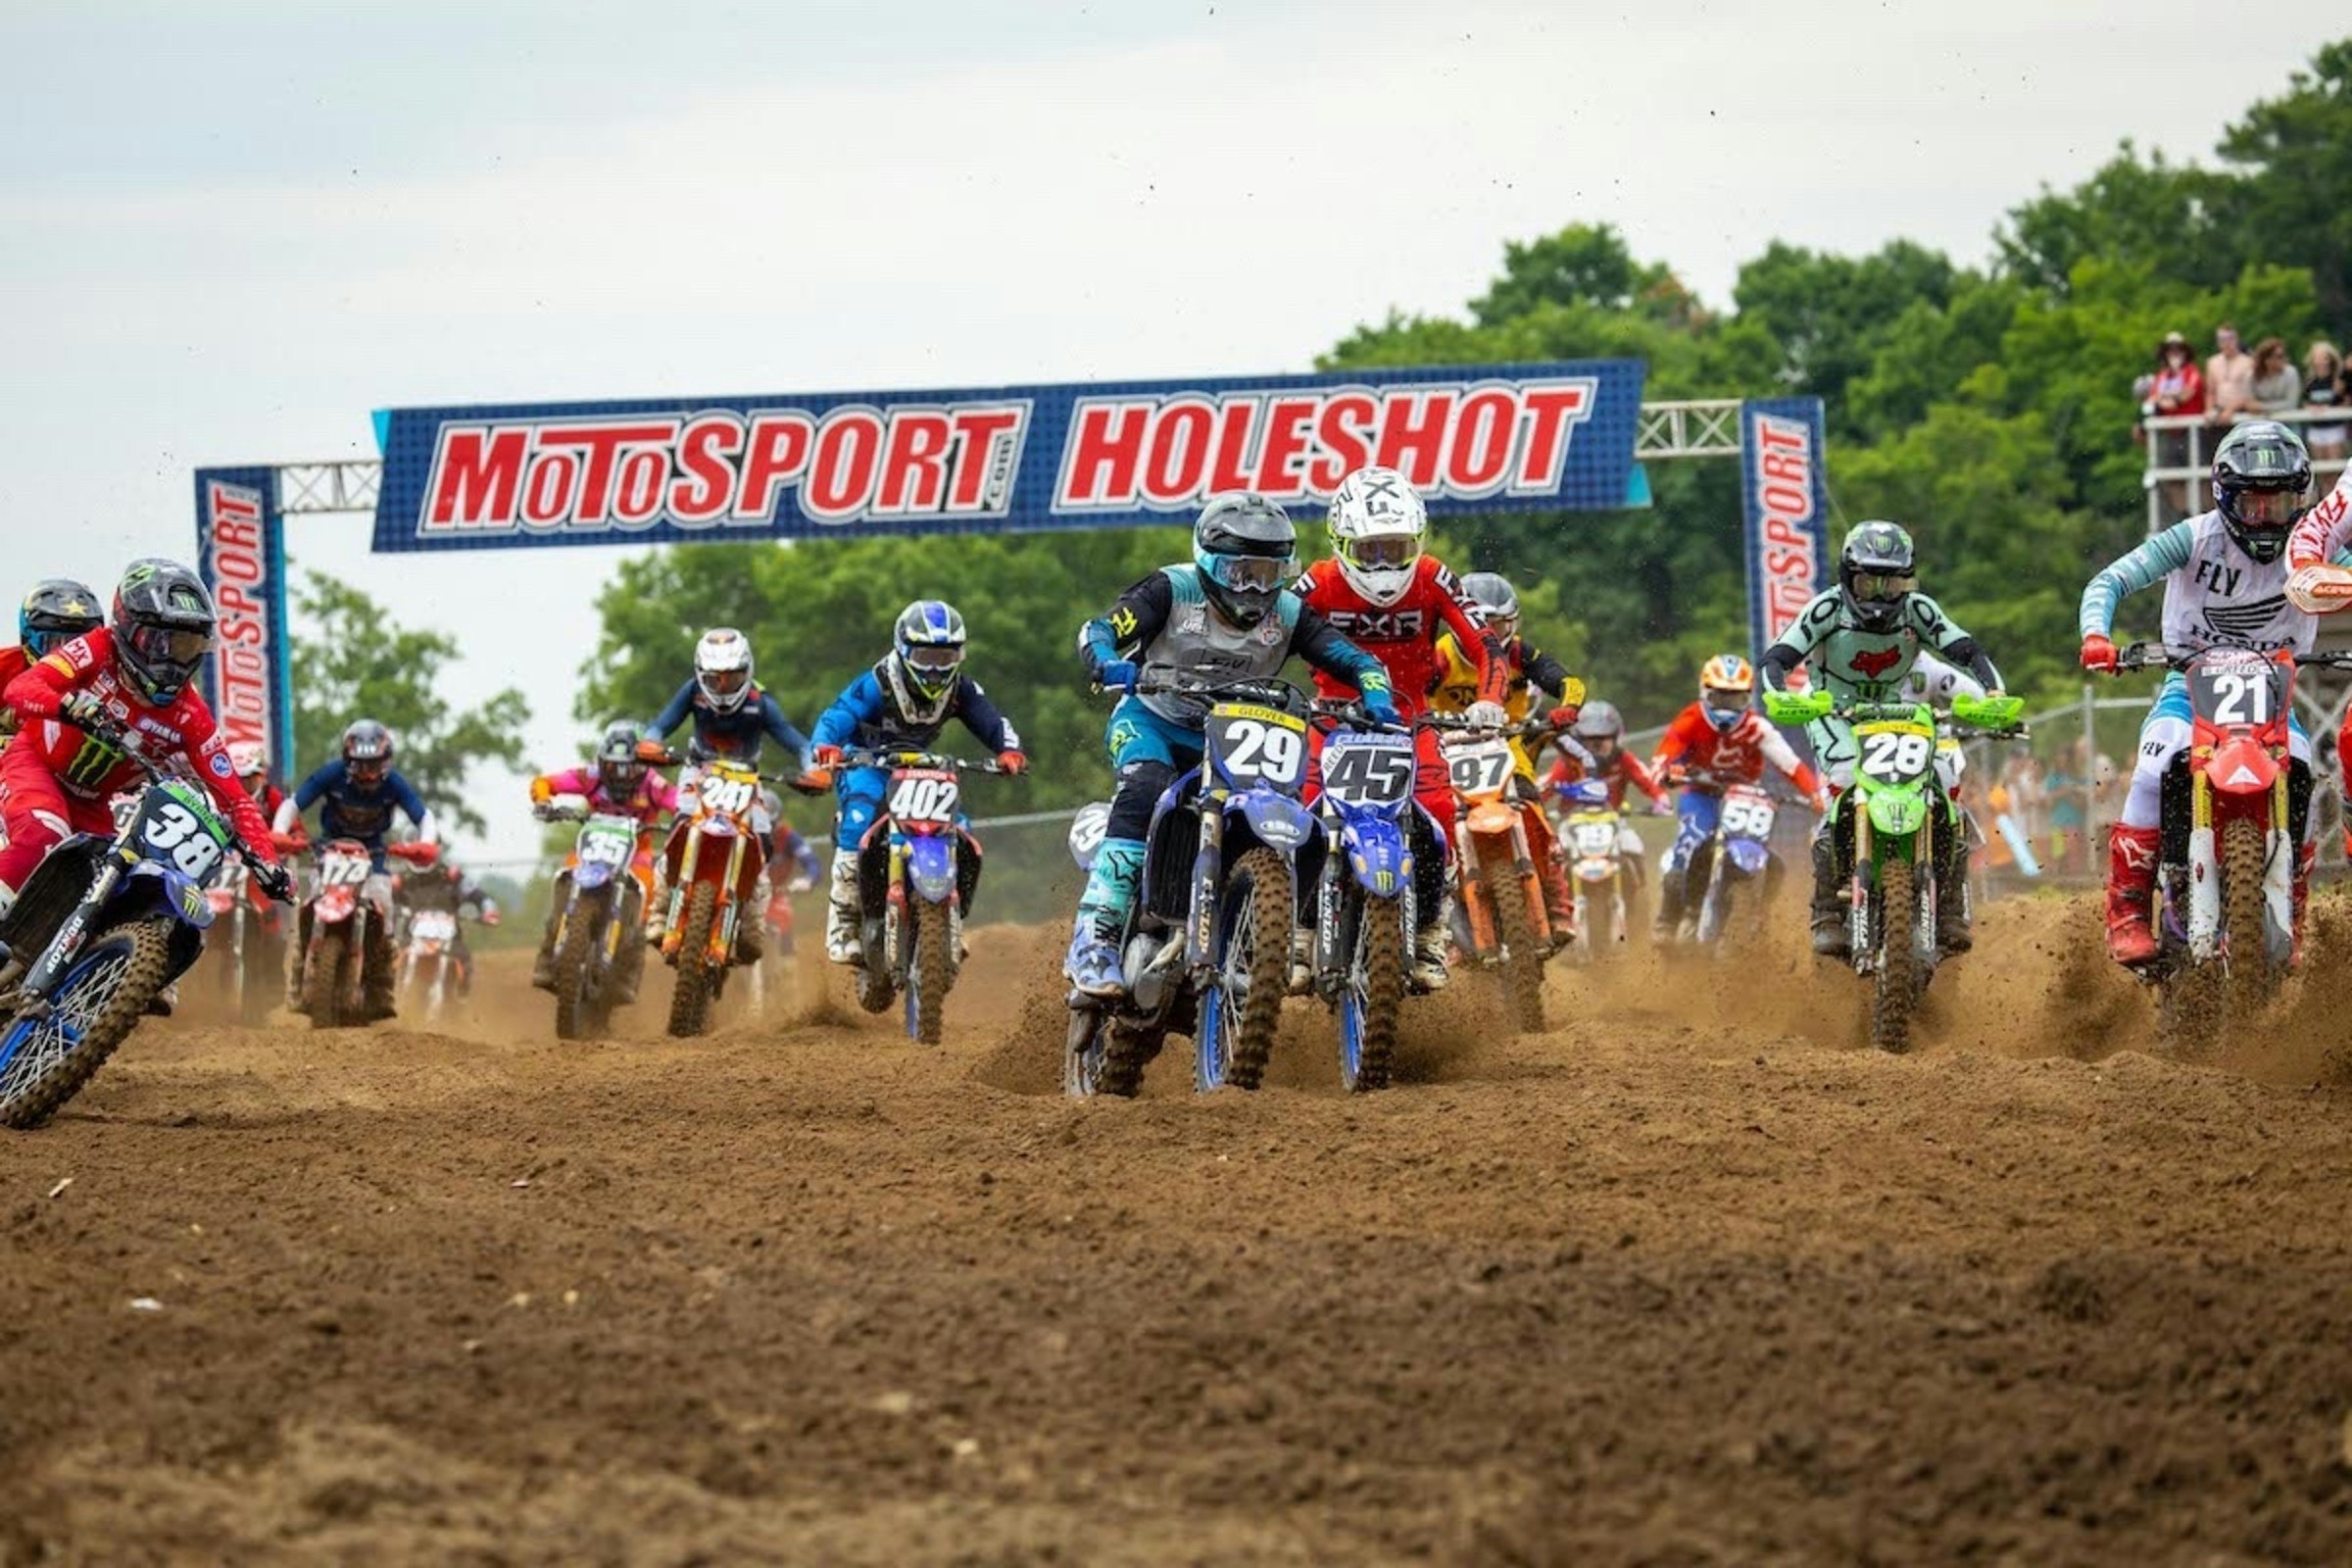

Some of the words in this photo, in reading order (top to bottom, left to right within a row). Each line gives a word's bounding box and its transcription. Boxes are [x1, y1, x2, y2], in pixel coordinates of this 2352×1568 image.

[1066, 390, 1584, 500] HOLESHOT
[2195, 560, 2242, 597] FLY
[1328, 611, 1424, 638] FXR
[1238, 707, 1287, 723] GLOVER
[2213, 673, 2267, 725] 21
[1224, 719, 1302, 783] 29
[1323, 744, 1346, 772] REED
[1862, 732, 1930, 774] 28
[2142, 742, 2166, 758] FLY
[1326, 749, 1413, 801] 45
[1451, 753, 1508, 792] 97
[702, 776, 754, 813] 241
[890, 779, 958, 821] 402
[1722, 799, 1775, 837] 58
[144, 803, 221, 879] 38
[581, 833, 629, 864] 35
